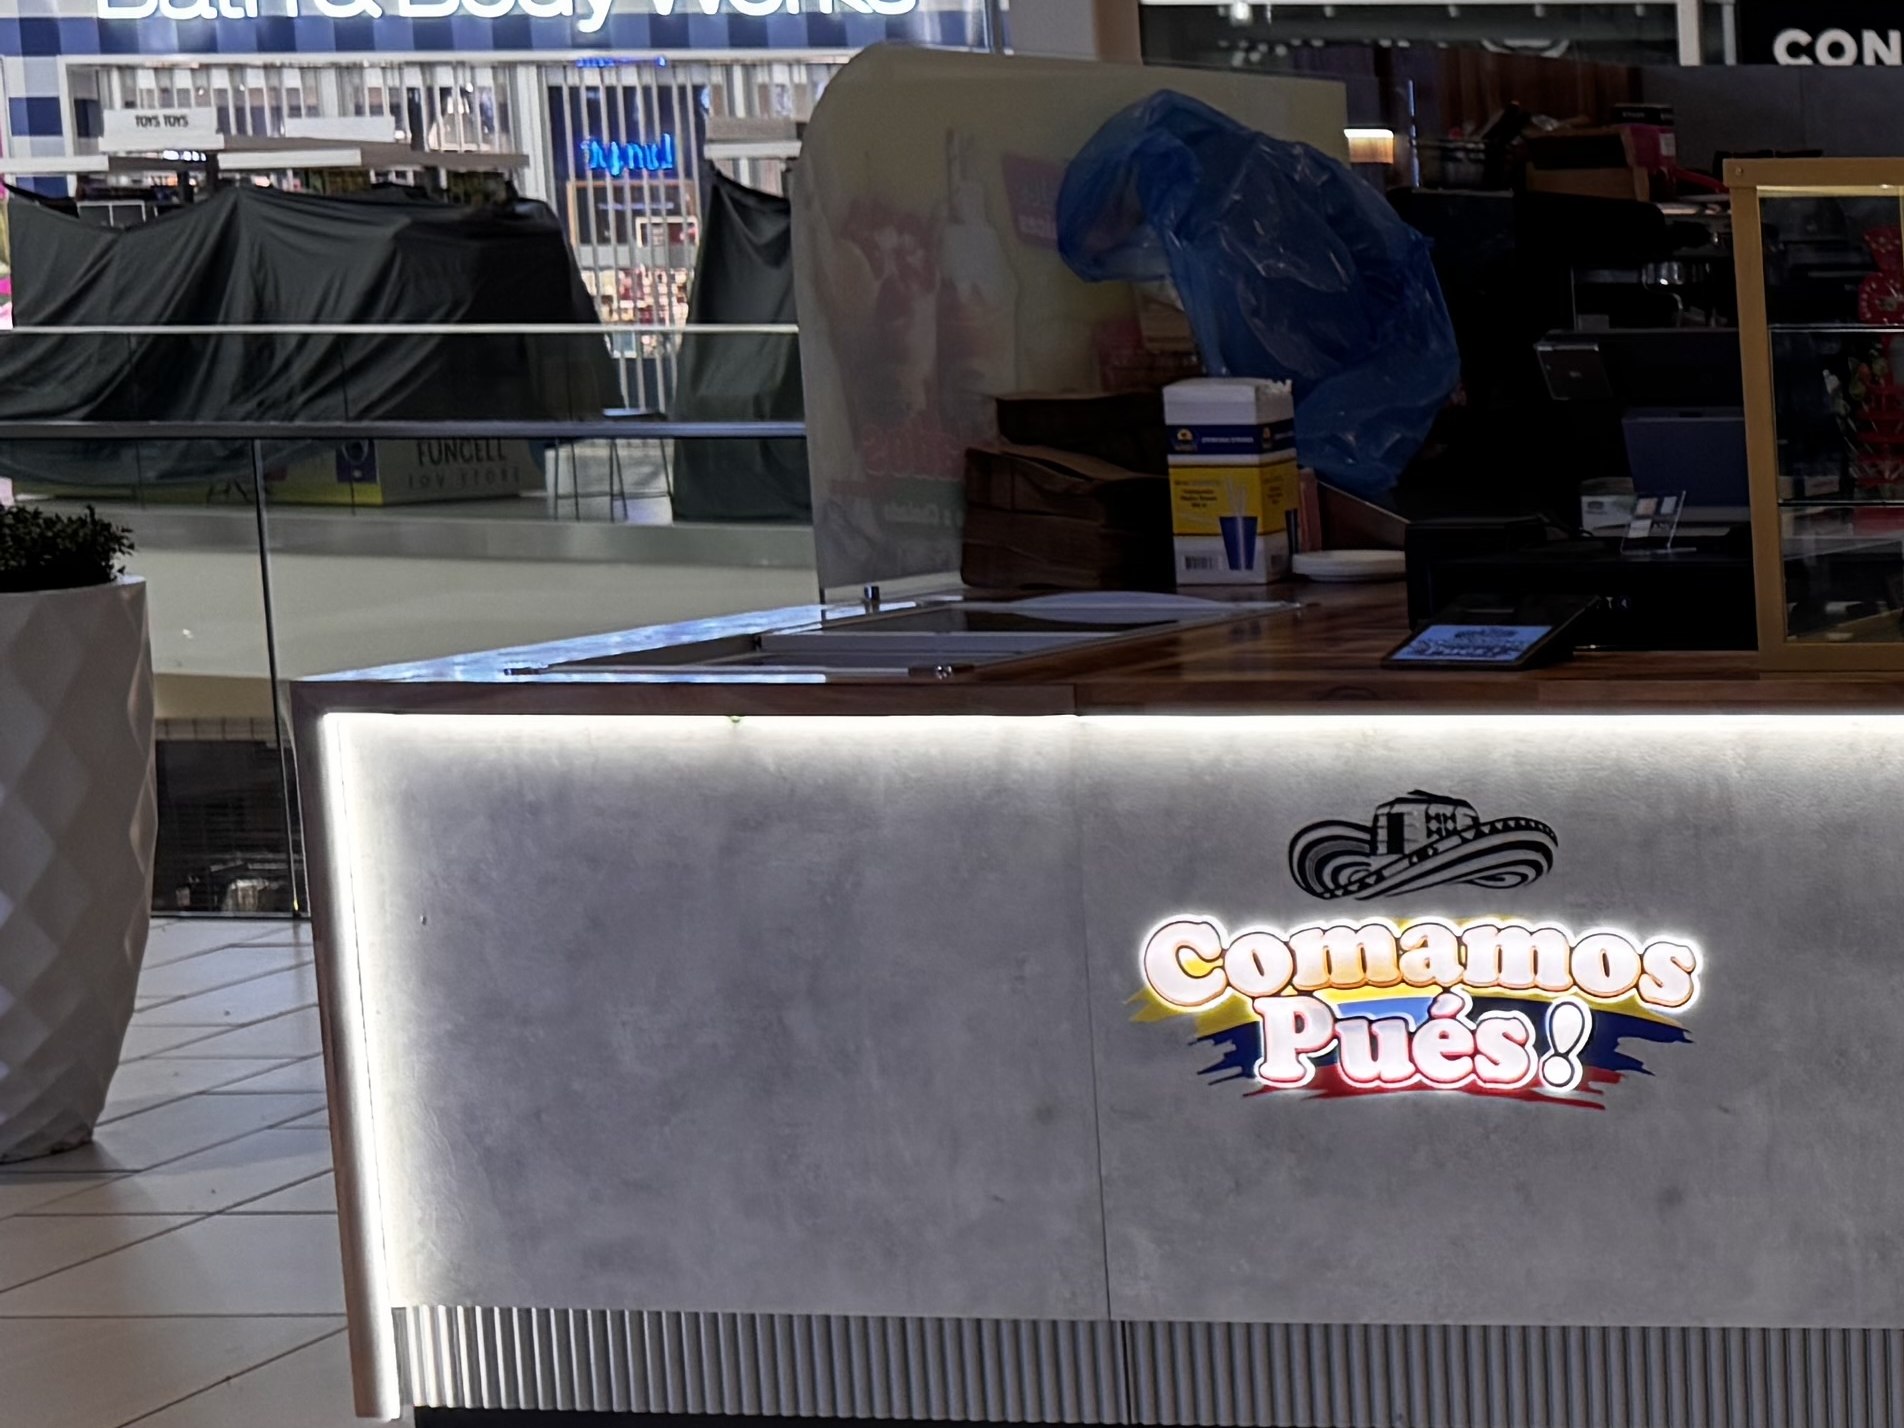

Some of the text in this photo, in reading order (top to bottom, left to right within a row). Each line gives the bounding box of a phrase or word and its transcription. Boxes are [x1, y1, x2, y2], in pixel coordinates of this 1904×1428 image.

[135, 114, 189, 128] TOYS TOYS
[1140, 915, 1702, 1010] Comamos
[1251, 985, 1593, 1091] Pués!
